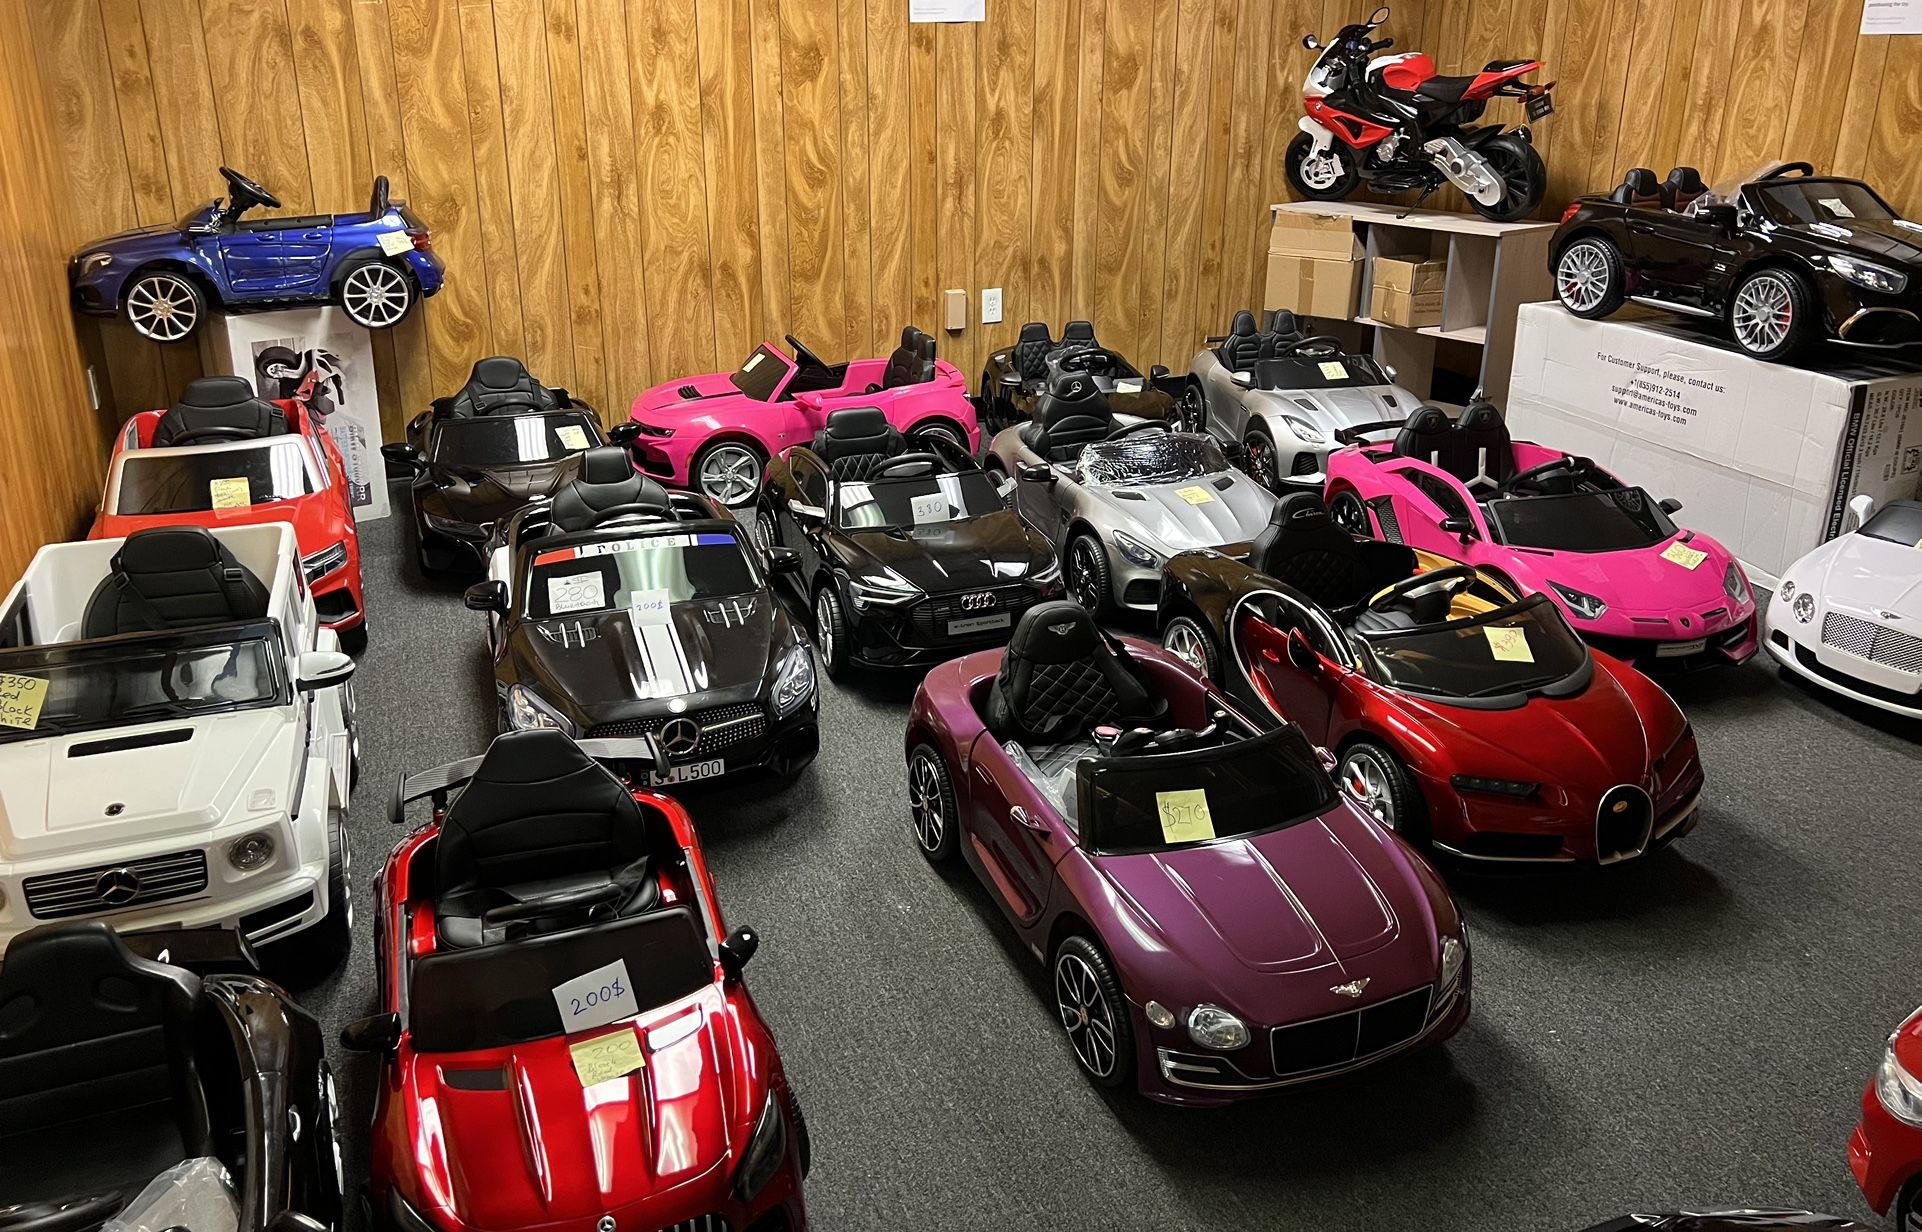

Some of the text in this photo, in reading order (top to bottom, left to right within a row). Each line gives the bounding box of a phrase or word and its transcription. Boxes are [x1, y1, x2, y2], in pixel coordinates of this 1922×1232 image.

[1597, 352, 1726, 394] For Customer Support, please, contact us:
[1611, 384, 1698, 416] support@americas-toys.com
[1613, 397, 1687, 425] www.americas-toys.com
[1850, 412, 1861, 436] BMW
[1843, 438, 1855, 469] Official
[1834, 471, 1849, 511] Licensed
[597, 537, 677, 554] POLICE
[554, 584, 599, 603] 280
[636, 599, 664, 611] 200$
[1162, 800, 1206, 833] $270
[570, 976, 626, 1016] 200$
[591, 1039, 632, 1060] 200
